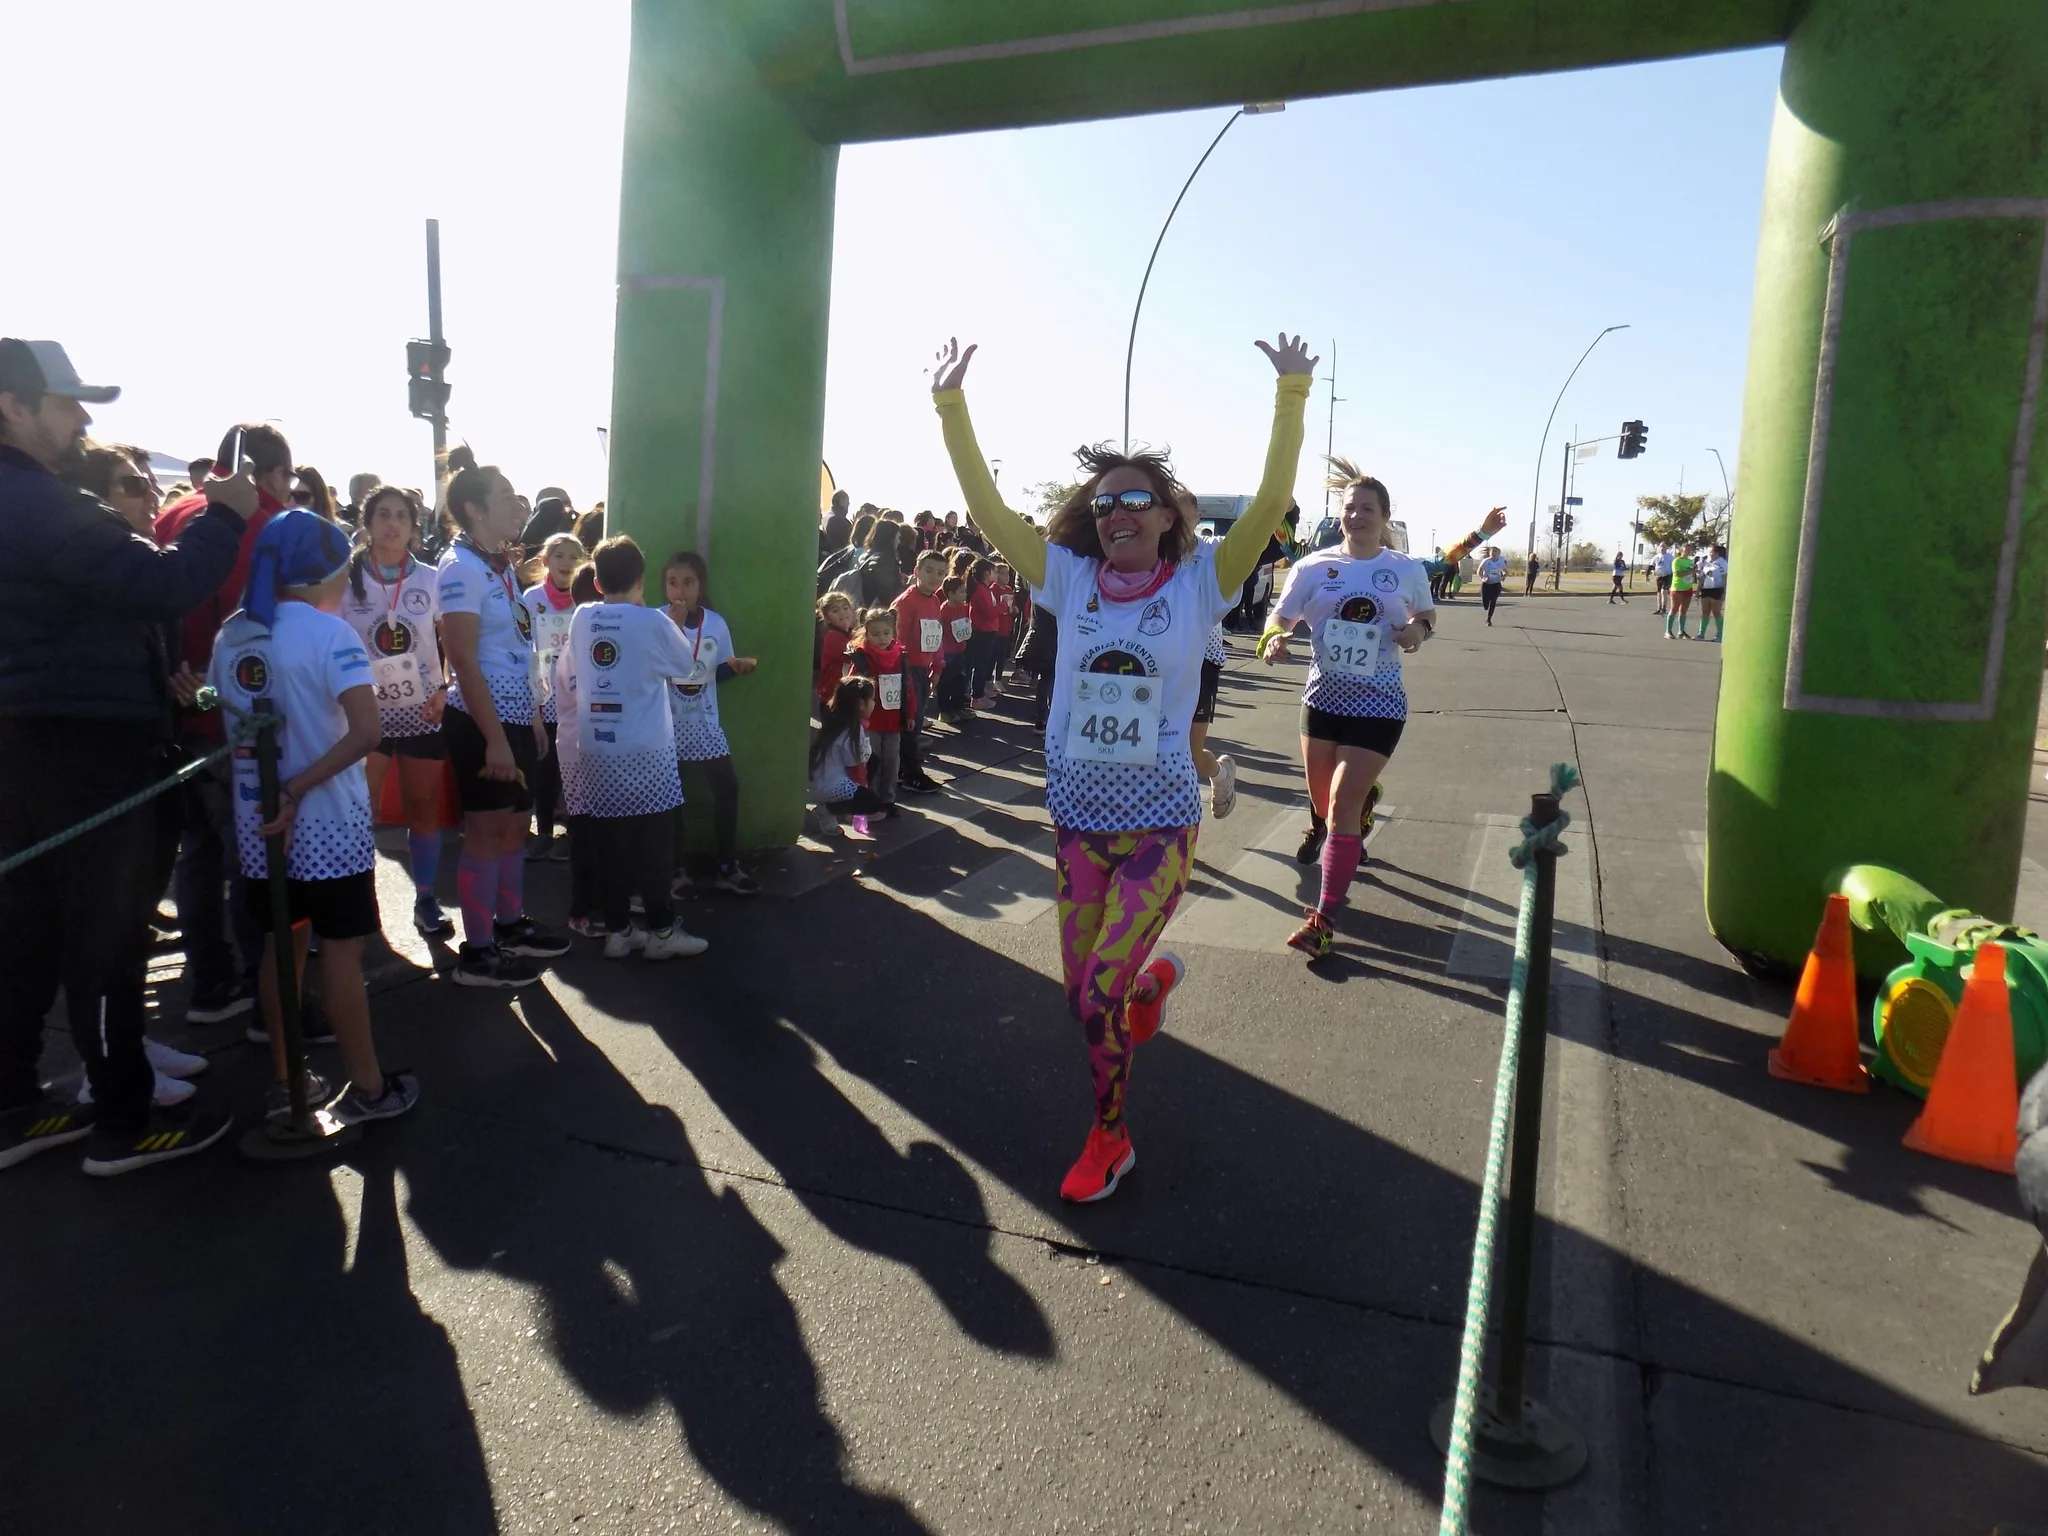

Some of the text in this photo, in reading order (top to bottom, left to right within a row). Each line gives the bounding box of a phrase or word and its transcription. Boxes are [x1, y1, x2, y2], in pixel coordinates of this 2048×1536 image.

[925, 635, 940, 646] 675
[1118, 638, 1124, 647] Y
[1125, 641, 1158, 674] EVENTOS
[1330, 644, 1368, 667] 312
[1081, 714, 1141, 747] 484
